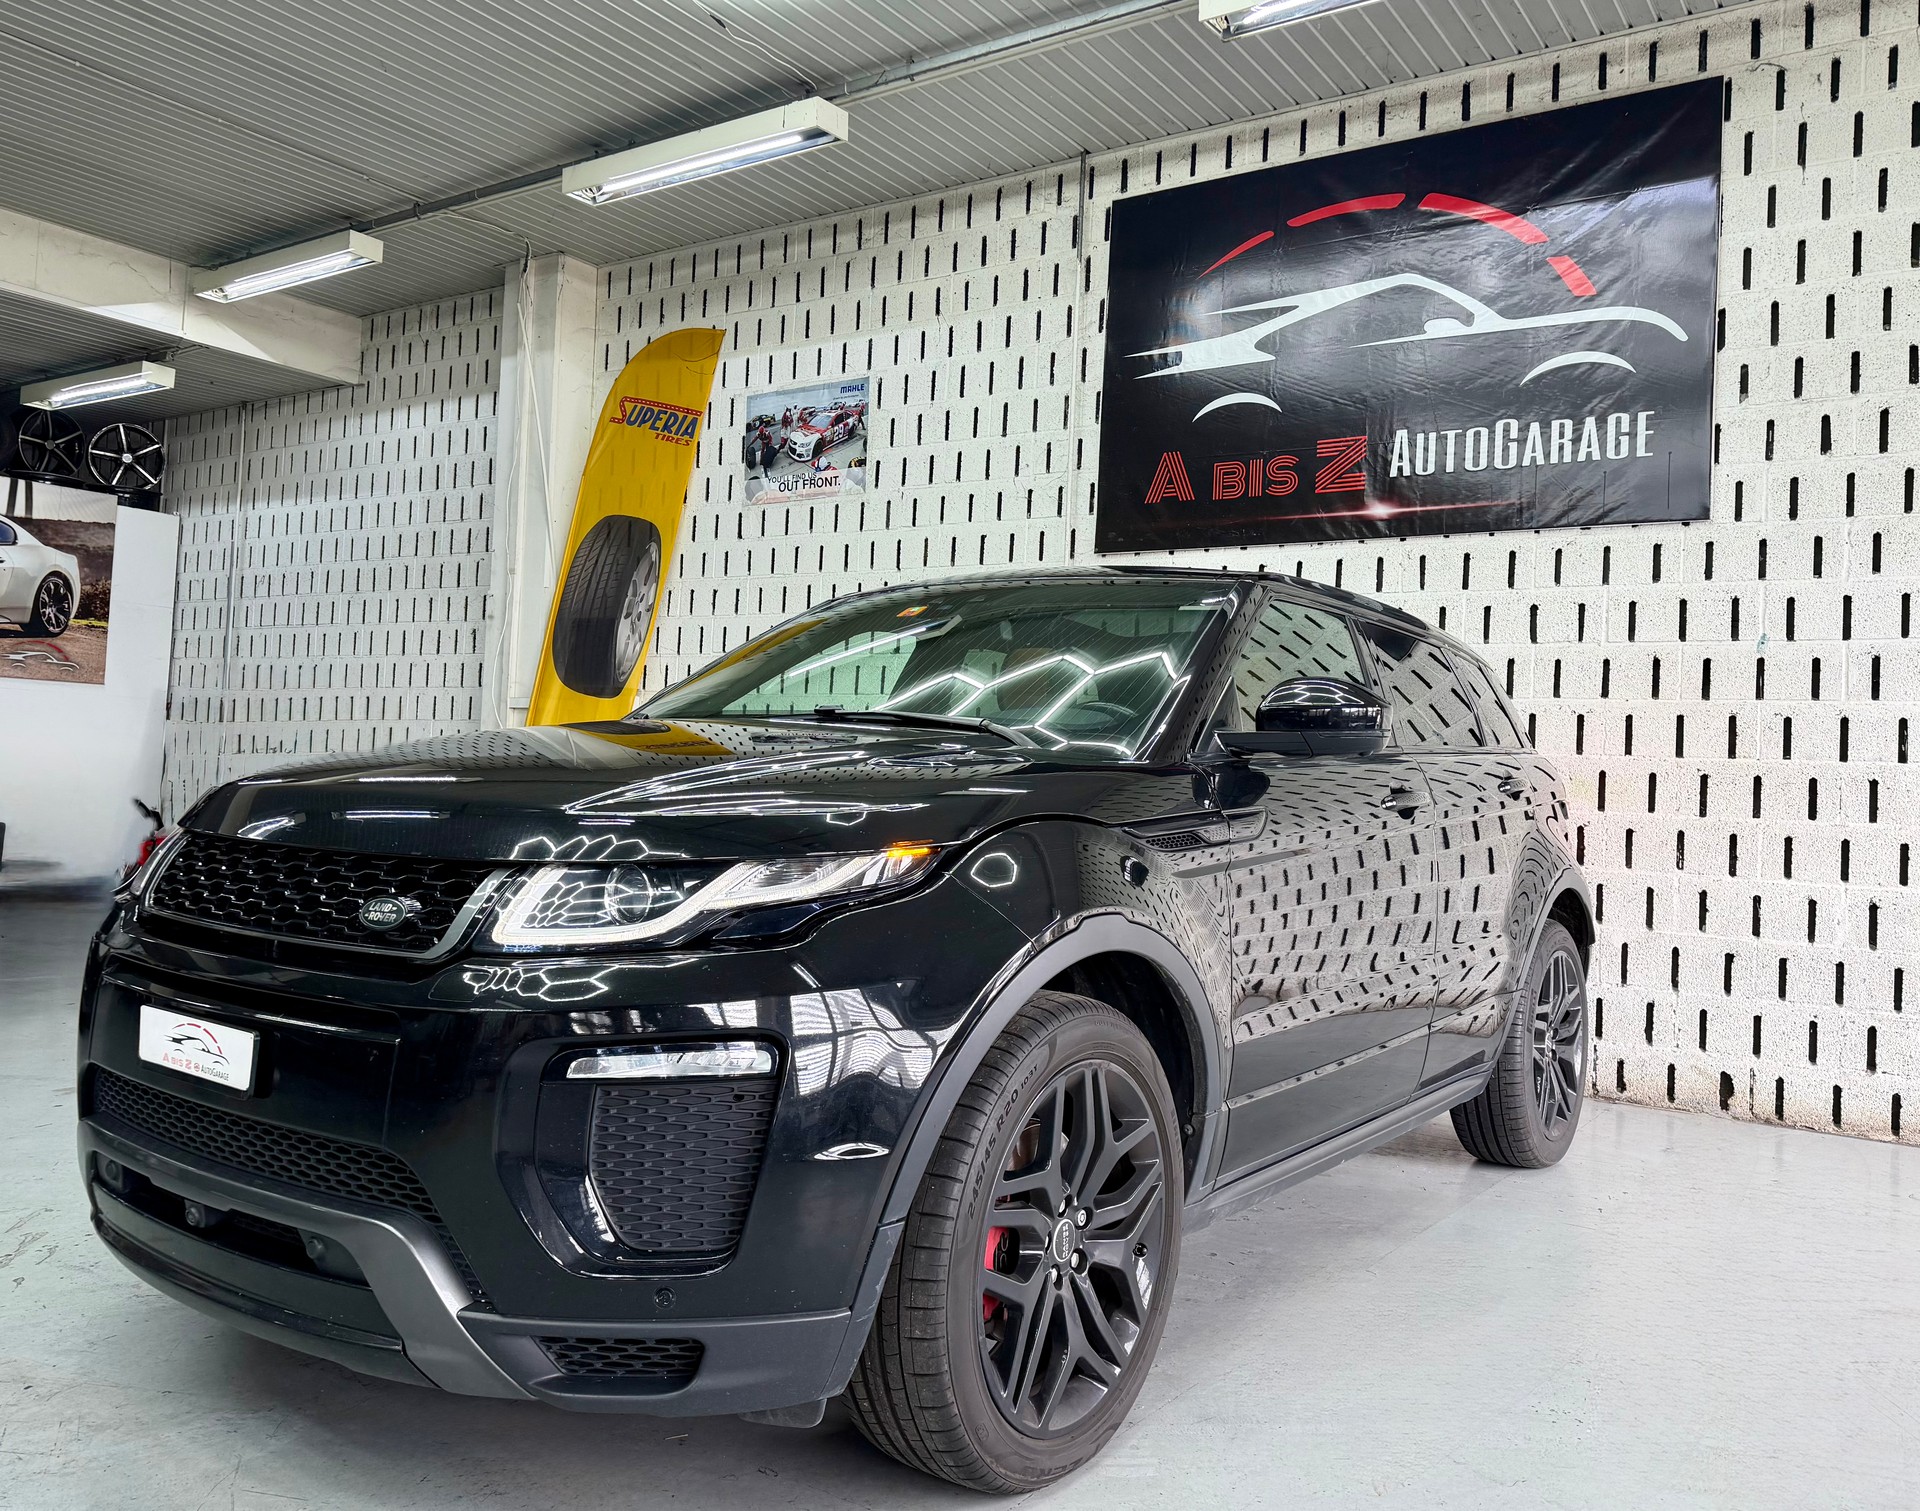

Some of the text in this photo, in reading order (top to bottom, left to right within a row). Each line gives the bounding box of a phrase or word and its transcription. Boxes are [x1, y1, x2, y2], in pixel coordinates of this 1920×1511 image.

[840, 384, 865, 394] MAHLE
[609, 396, 703, 439] SUPERIA
[654, 432, 692, 447] TIRES
[834, 424, 844, 440] 29
[1145, 450, 1196, 504] A
[1212, 455, 1300, 501] BIS
[1315, 435, 1369, 494] Z
[779, 480, 800, 492] OUT
[162, 1052, 170, 1063] A
